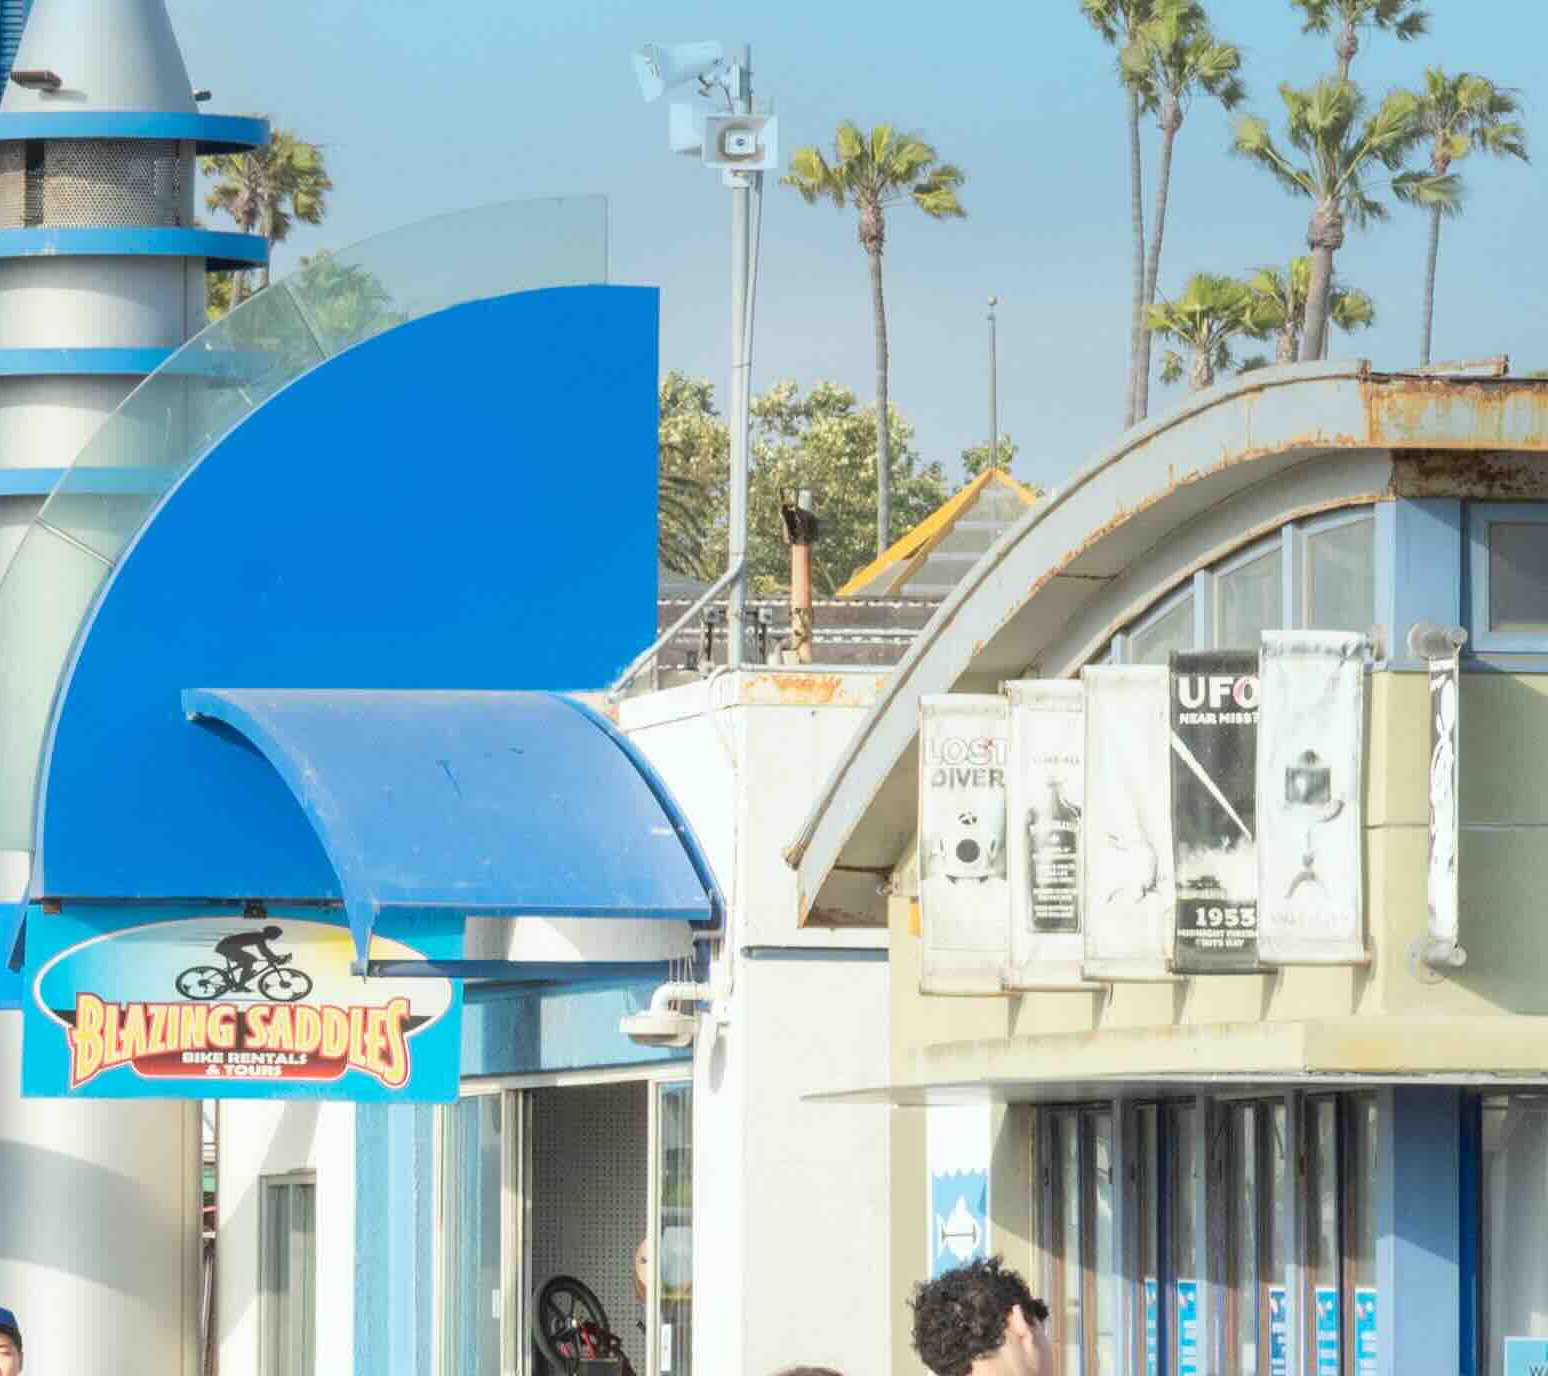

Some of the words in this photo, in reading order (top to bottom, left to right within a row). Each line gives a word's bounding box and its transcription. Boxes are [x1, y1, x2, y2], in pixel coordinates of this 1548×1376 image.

[1178, 676, 1259, 708] UFO
[1179, 712, 1217, 725] NEAR
[924, 737, 1006, 766] LOST
[932, 767, 1006, 789] DIVER
[72, 992, 237, 1088] BLAZING
[244, 997, 410, 1087] SADDLES
[182, 1051, 224, 1065] BIKE
[227, 1051, 308, 1066] RENTALS
[224, 1064, 283, 1077] TOURS
